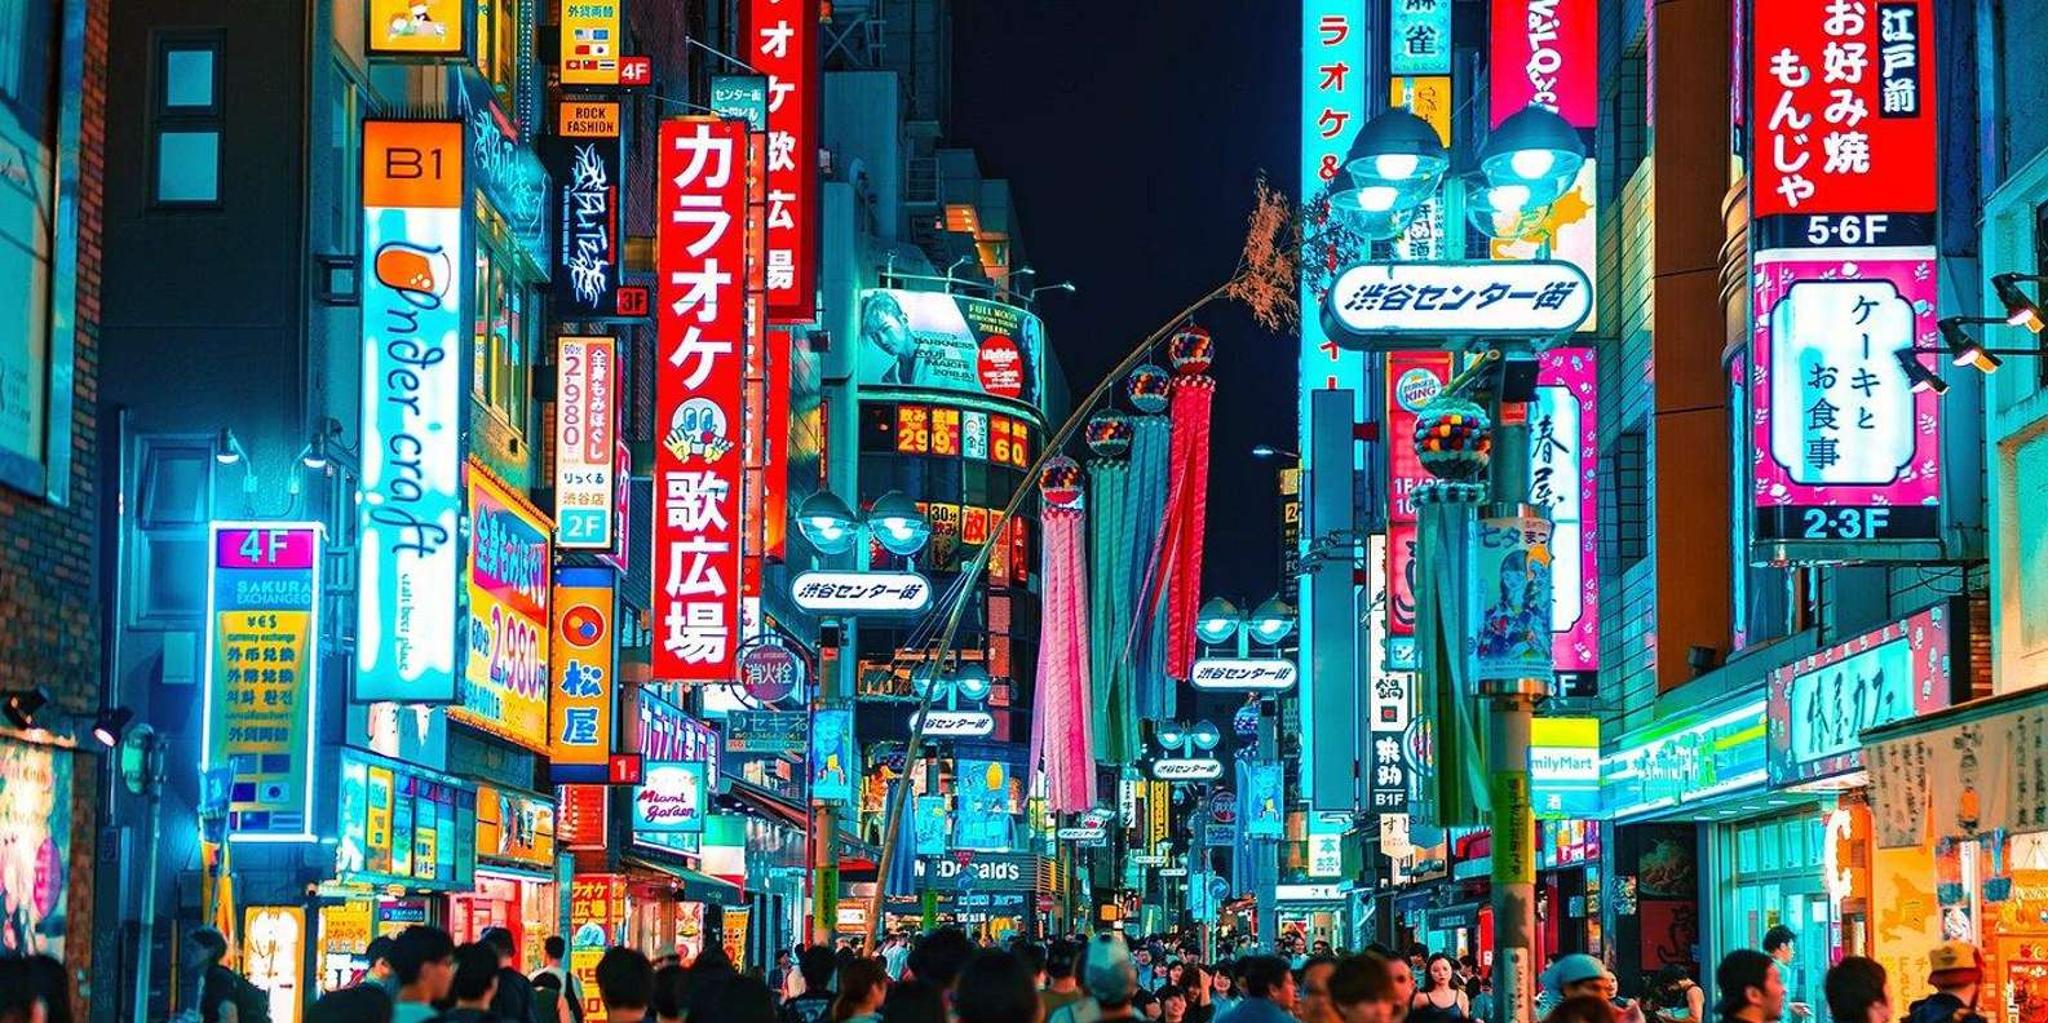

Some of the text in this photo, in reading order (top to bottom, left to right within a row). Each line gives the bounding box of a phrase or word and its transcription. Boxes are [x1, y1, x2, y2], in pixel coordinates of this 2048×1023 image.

[1881, 8, 1916, 113] 江戸前
[621, 63, 648, 80] 4F
[1823, 0, 1870, 174] お好み焼
[575, 107, 606, 119] ROCK
[567, 121, 614, 133] FASHION
[1768, 48, 1815, 208] もんじゃ
[386, 147, 442, 180] B1
[622, 292, 643, 311] 3F
[1344, 281, 1578, 312] 渋谷センター街
[1851, 295, 1881, 430] ケーキと
[663, 124, 734, 664] カラオケ 歌広場
[1405, 387, 1436, 402] KING
[1807, 362, 1841, 470] お食事
[563, 473, 604, 484] りっくる
[369, 433, 449, 559] craft
[563, 493, 604, 505] 渋谷店
[566, 516, 600, 537] 2F
[240, 530, 289, 564] 4F
[237, 580, 310, 593] SAKURA
[799, 582, 923, 600] 渋谷センター街
[745, 662, 793, 684] 消火栓
[1196, 666, 1291, 681] 渋谷センター街
[560, 660, 603, 745] 松屋
[748, 712, 809, 732] セキネ
[914, 717, 990, 730] 谷センター街
[1375, 793, 1404, 805] B1F
